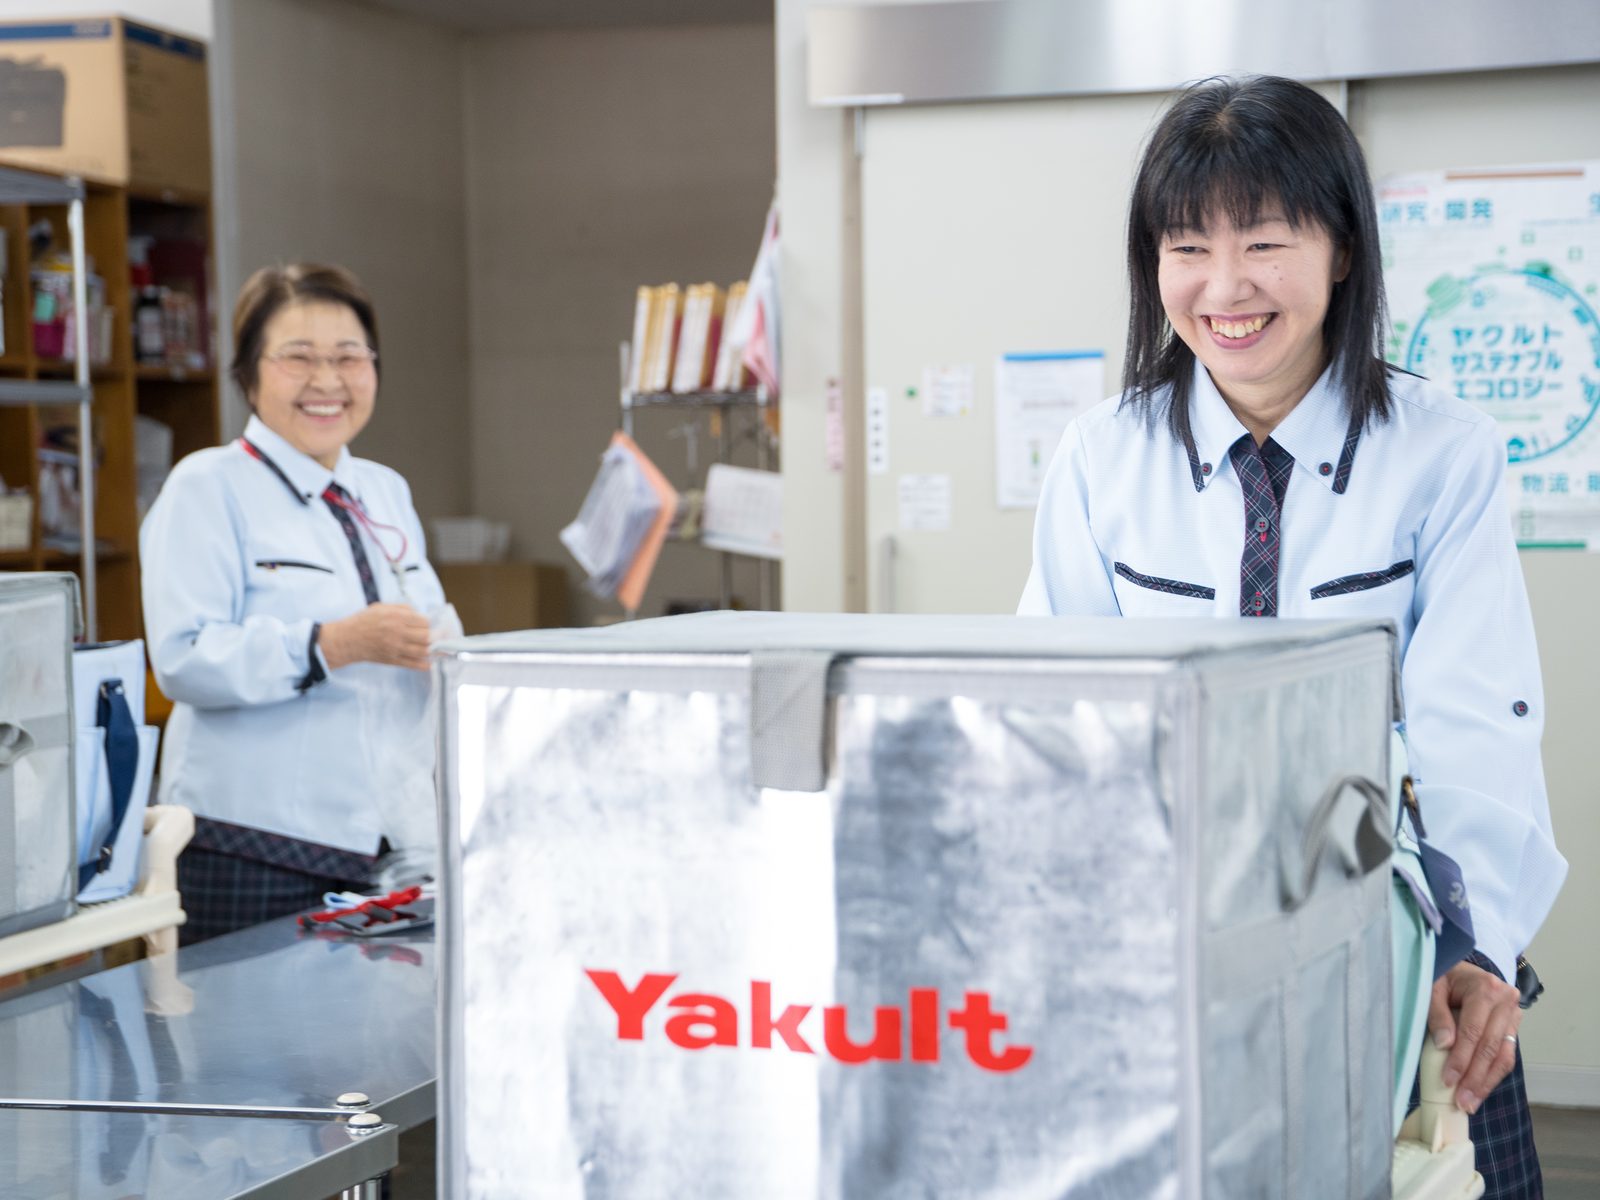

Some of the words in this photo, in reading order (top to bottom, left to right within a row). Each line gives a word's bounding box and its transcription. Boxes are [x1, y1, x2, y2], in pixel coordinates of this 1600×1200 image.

[1452, 324, 1563, 347] ヤクルト
[1451, 351, 1562, 373] サステナブル
[1454, 377, 1563, 399] エコロジー
[584, 968, 1034, 1073] Yakult
